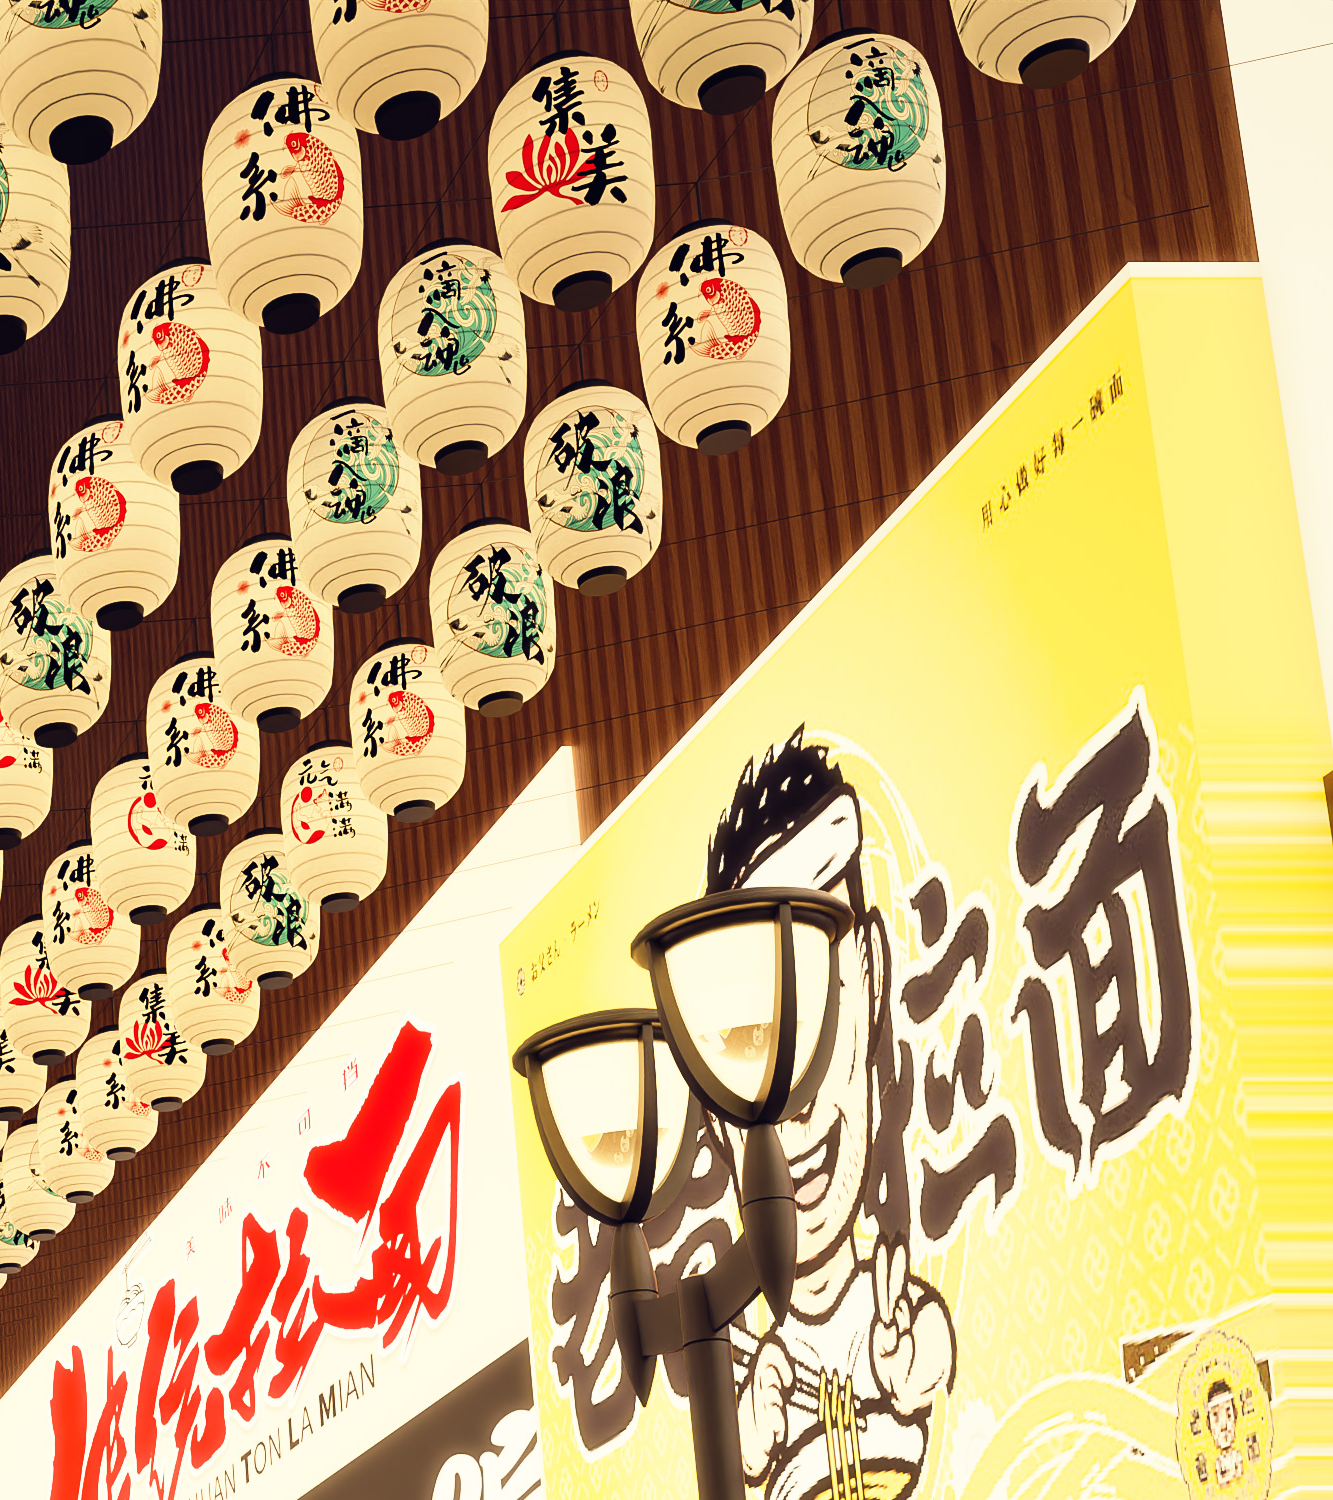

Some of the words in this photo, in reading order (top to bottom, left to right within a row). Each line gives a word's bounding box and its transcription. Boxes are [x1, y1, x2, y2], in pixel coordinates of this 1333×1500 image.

[240, 85, 330, 221] 佛系
[532, 67, 627, 204] 集美
[126, 276, 195, 414] 佛系
[662, 234, 744, 364] 佛系
[54, 434, 113, 559] 佛系
[550, 410, 643, 535] 破浪
[9, 576, 91, 694] 破浪
[240, 549, 298, 653] 佛系
[463, 543, 546, 666] 破浪
[165, 667, 221, 768] 佛系
[362, 655, 422, 758] 佛系
[329, 791, 355, 838] 满满
[241, 852, 307, 950] 破浪
[139, 984, 188, 1065] 集美
[186, 1058, 359, 1261] 美味不可挡
[241, 1428, 281, 1484] TON
[288, 1406, 314, 1450] LA
[319, 1354, 375, 1427] MIAN
